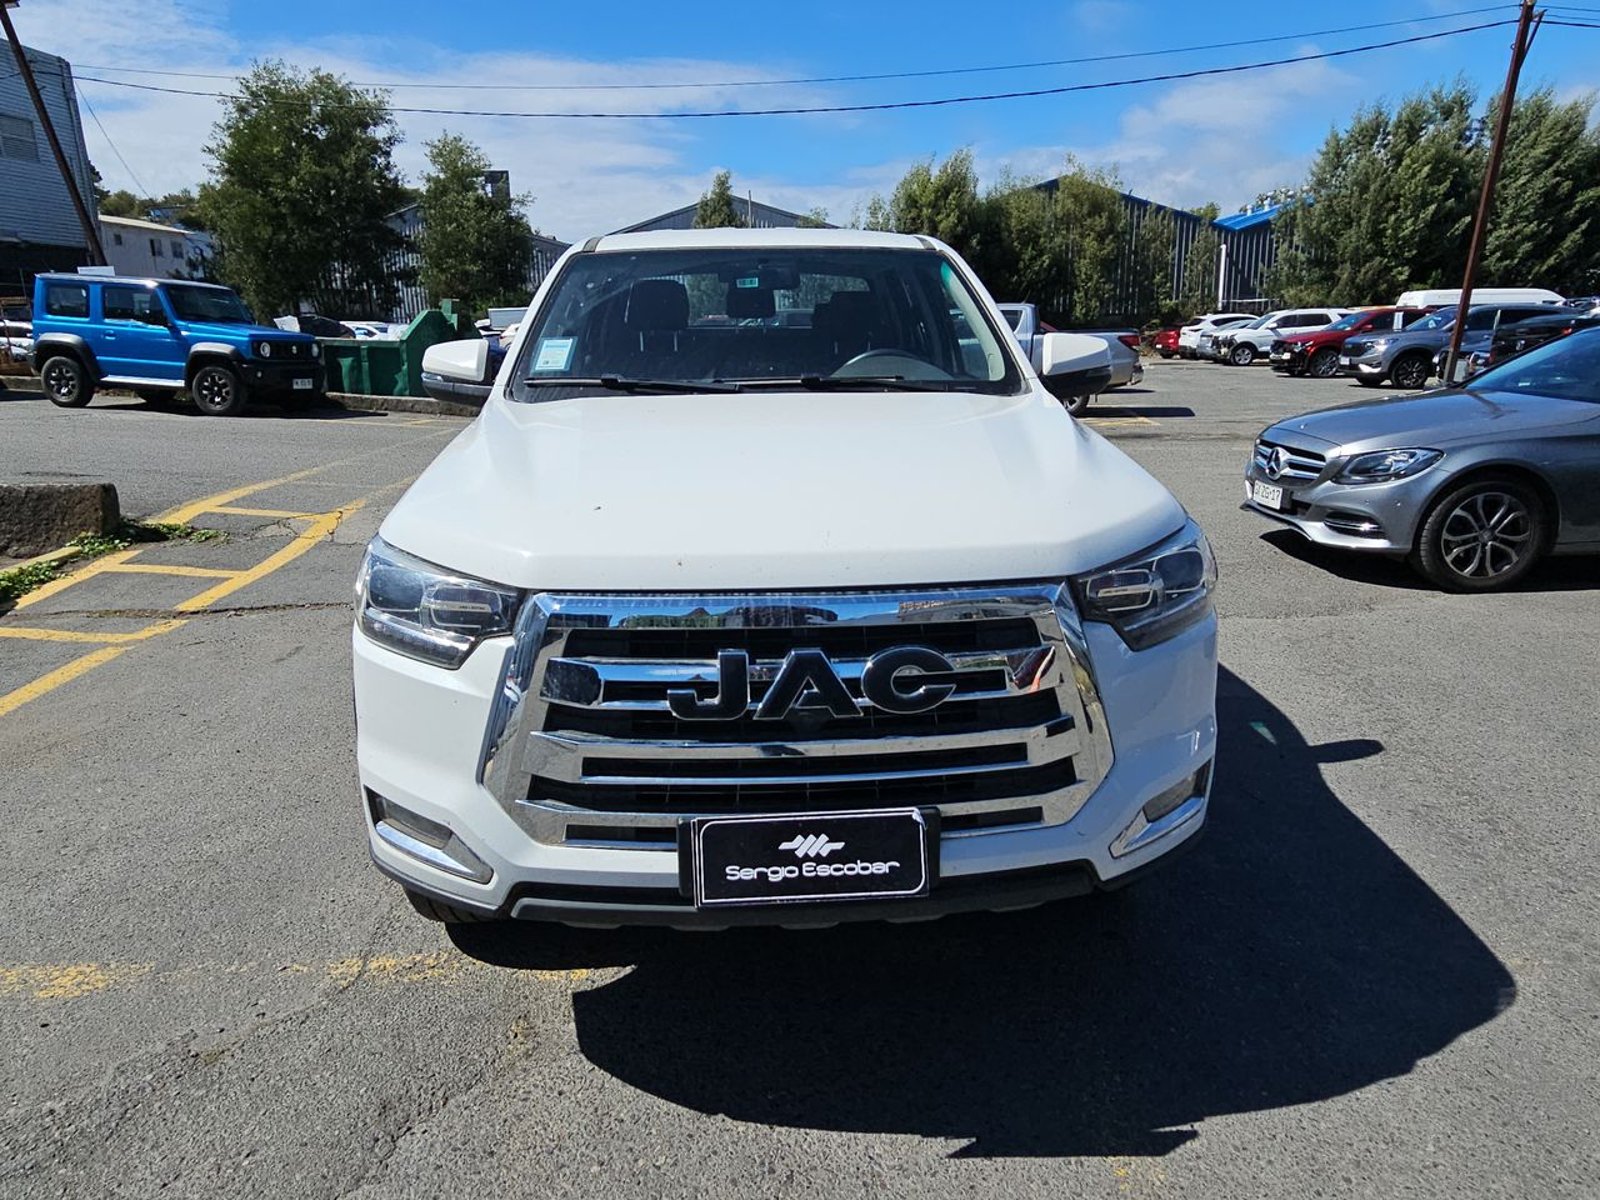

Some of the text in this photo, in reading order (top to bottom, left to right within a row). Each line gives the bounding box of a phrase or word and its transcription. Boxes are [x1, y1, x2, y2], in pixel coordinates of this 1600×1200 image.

[666, 645, 957, 721] JAC
[725, 859, 901, 882] Sergio Escobar
